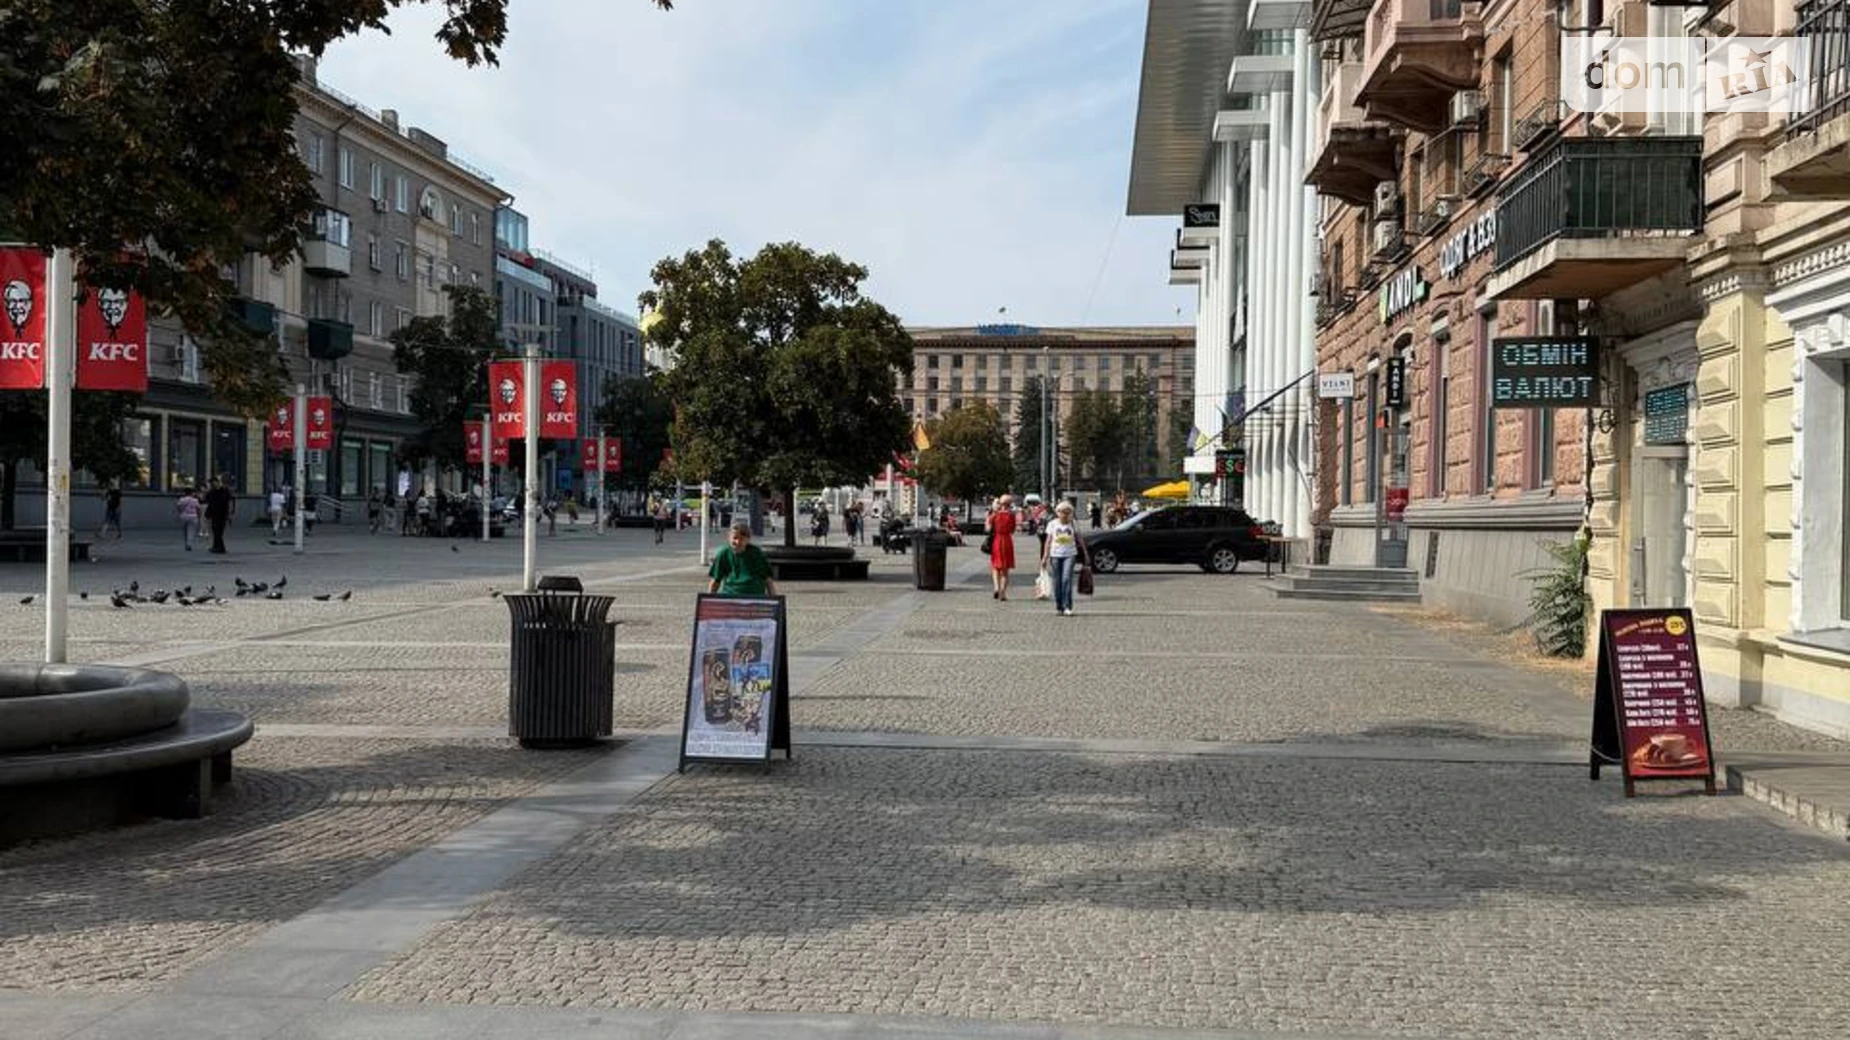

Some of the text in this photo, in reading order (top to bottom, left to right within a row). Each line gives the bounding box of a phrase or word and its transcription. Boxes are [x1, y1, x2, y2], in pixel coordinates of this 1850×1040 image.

[0, 342, 41, 359] KFC
[88, 342, 139, 361] KFC
[1502, 343, 1588, 366] ОБМІН
[1495, 376, 1593, 400] ВАЛЮТ
[497, 412, 522, 423] KFC
[546, 412, 573, 423] KFC
[272, 430, 292, 439] KFC
[309, 431, 330, 440] KFC
